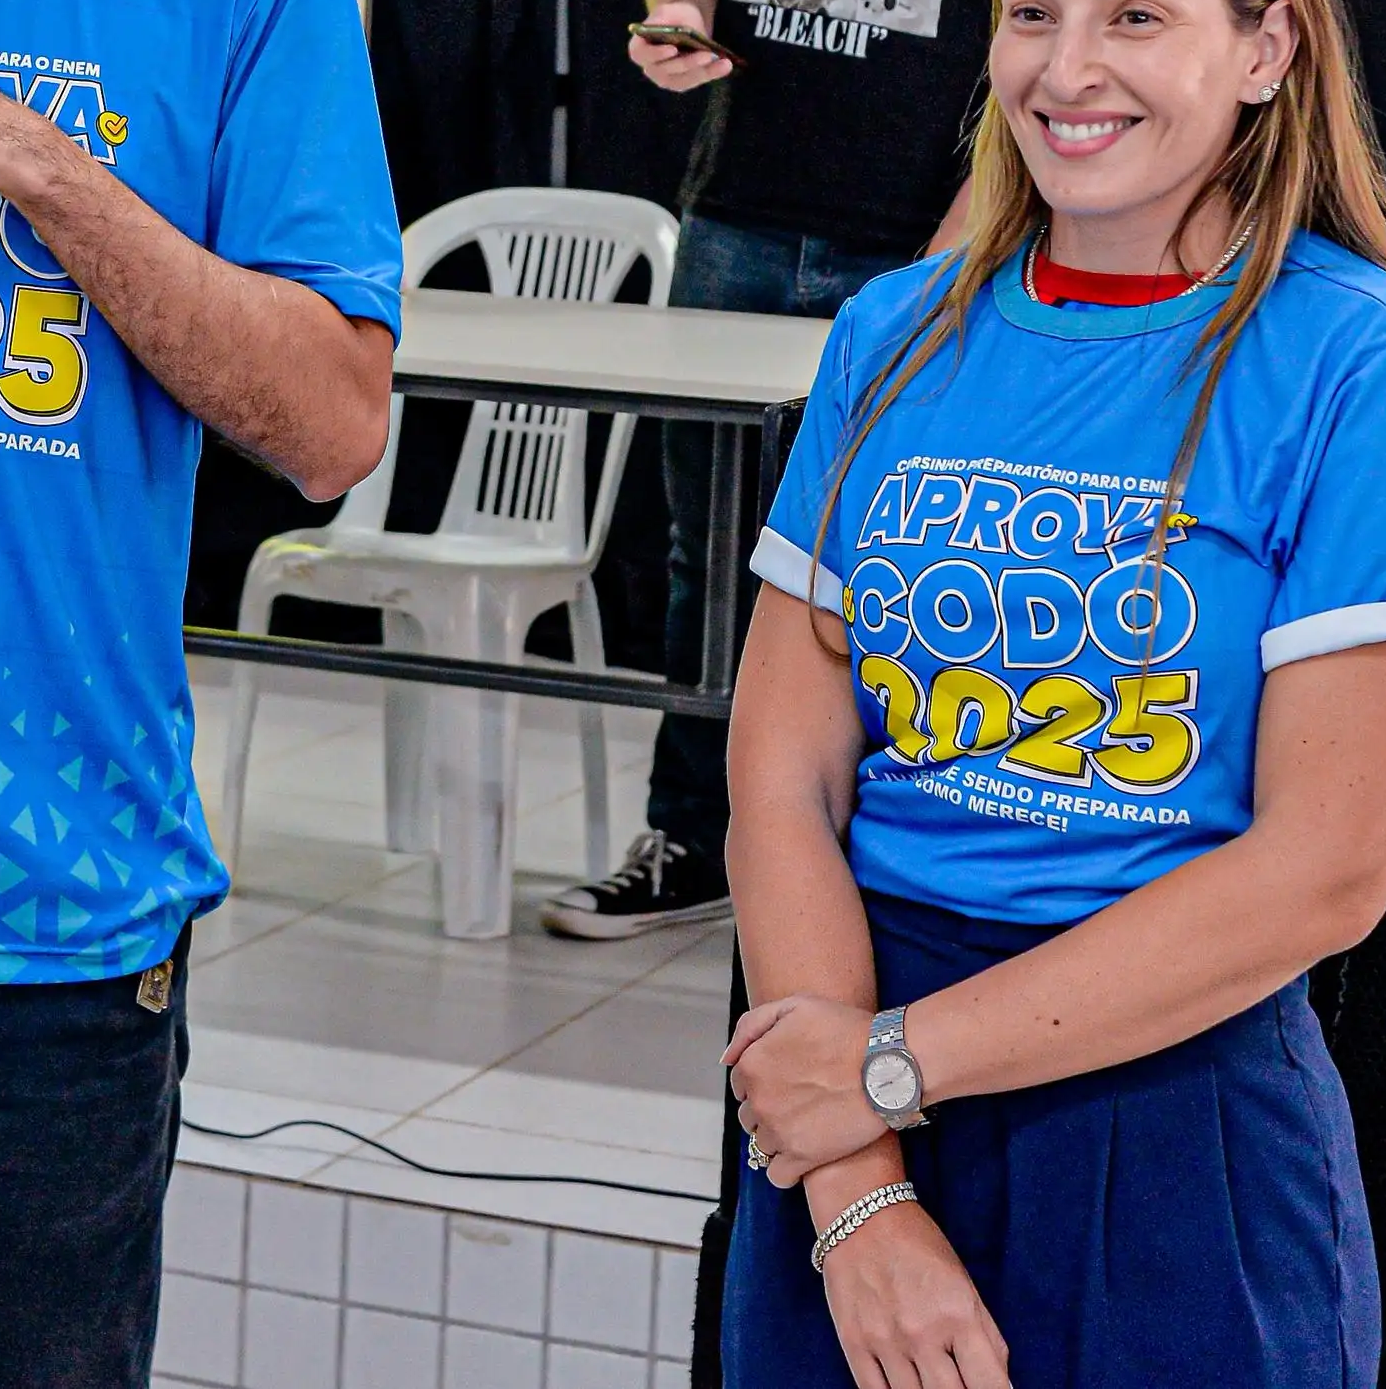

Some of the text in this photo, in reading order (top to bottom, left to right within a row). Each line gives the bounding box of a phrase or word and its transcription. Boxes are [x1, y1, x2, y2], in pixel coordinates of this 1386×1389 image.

[35, 56, 50, 70] O
[52, 58, 101, 78] ENEM
[1080, 472, 1121, 490] PARA
[1123, 477, 1137, 491] O
[1139, 478, 1185, 496] ENE
[859, 651, 1202, 796] 2025
[962, 770, 1034, 804] SENDO
[1040, 790, 1191, 826] PREPARADA
[968, 794, 1069, 833] MERECE!
